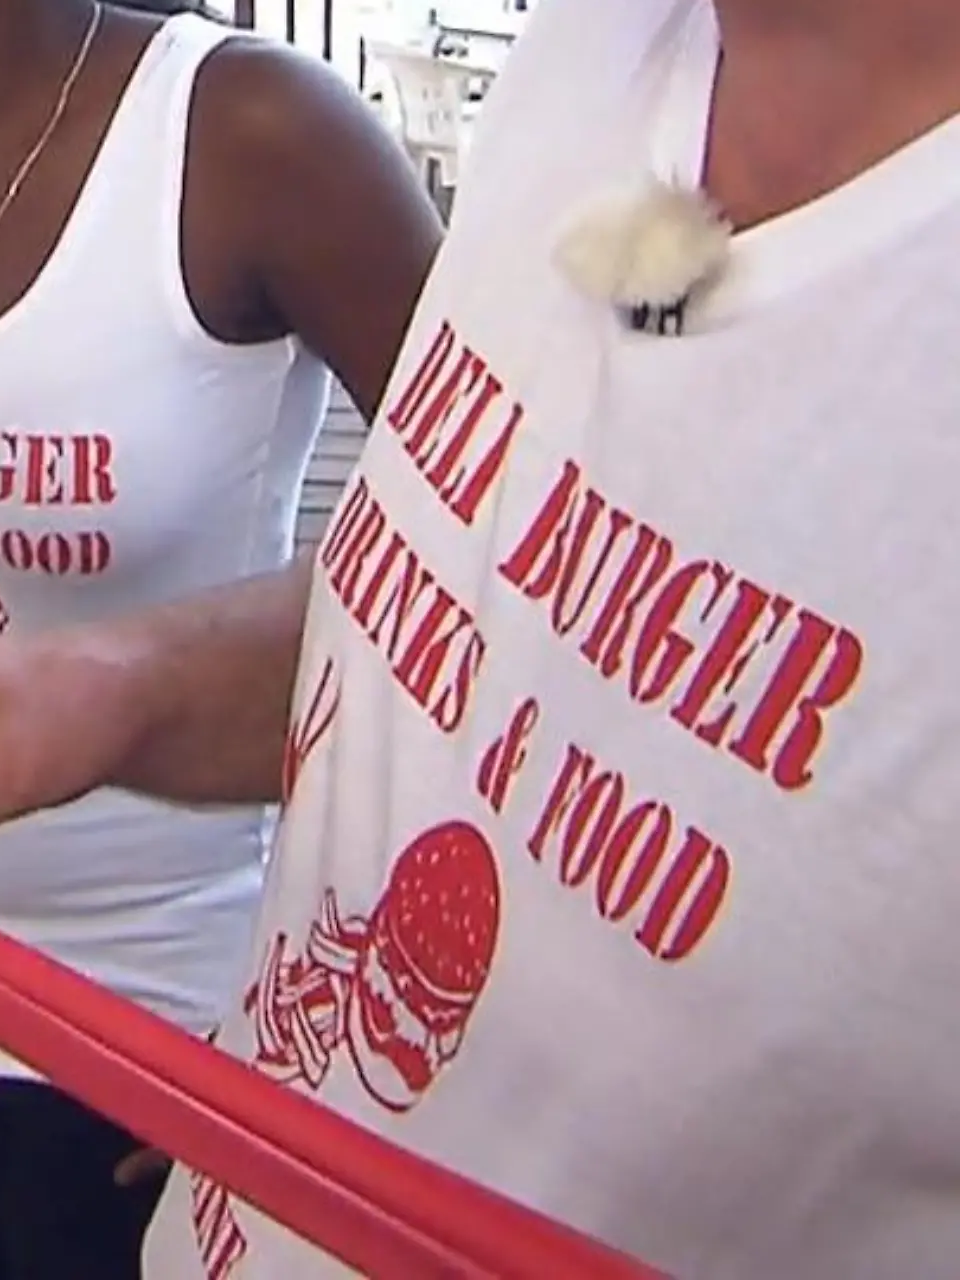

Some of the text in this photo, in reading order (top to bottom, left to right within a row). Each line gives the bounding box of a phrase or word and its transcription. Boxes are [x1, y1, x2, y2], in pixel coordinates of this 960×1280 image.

[321, 475, 731, 963] DRINKS & FOOD
[387, 319, 864, 793] DELI BURGER
